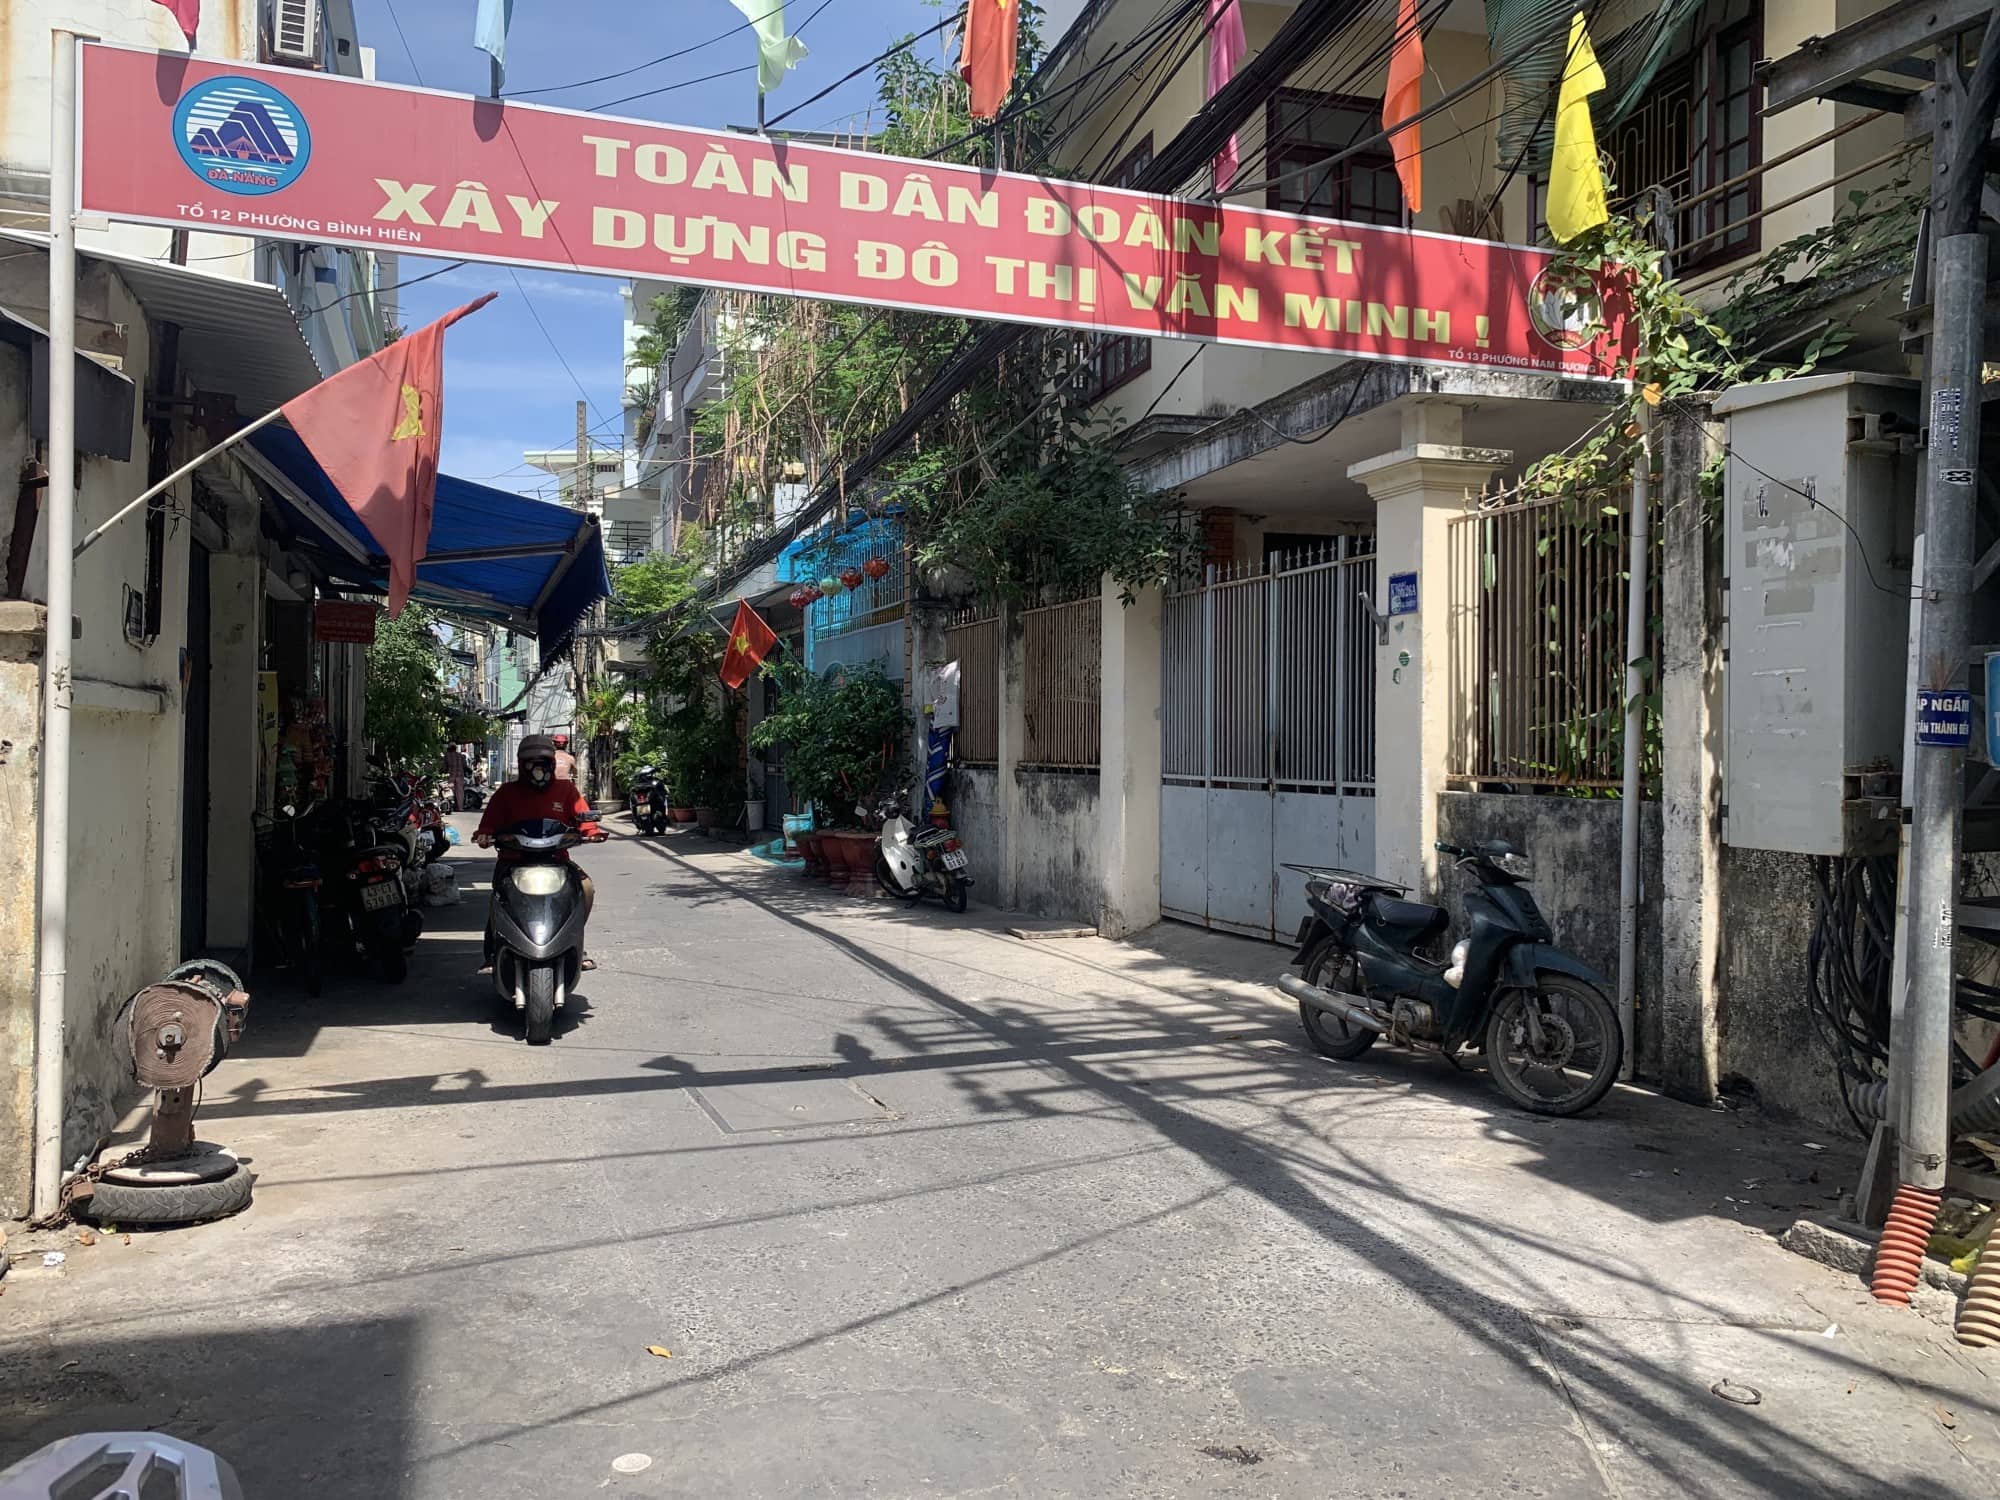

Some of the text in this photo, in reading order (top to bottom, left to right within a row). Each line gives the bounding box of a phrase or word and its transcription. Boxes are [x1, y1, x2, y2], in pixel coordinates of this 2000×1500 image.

[177, 202, 422, 242] TỔ 12 PHƯỜNG BÌNH HIÊN
[582, 135, 1361, 275] TOÀN DÂN ĐOÀN KẾT
[372, 179, 561, 240] XÂY
[592, 206, 827, 273] DỰNG
[854, 240, 959, 288] ĐÔ
[985, 256, 1097, 312] THỊ
[1122, 271, 1259, 323] VĂN
[1284, 292, 1450, 344] MINH
[1467, 352, 1479, 361] 13
[1531, 358, 1555, 370] NAM
